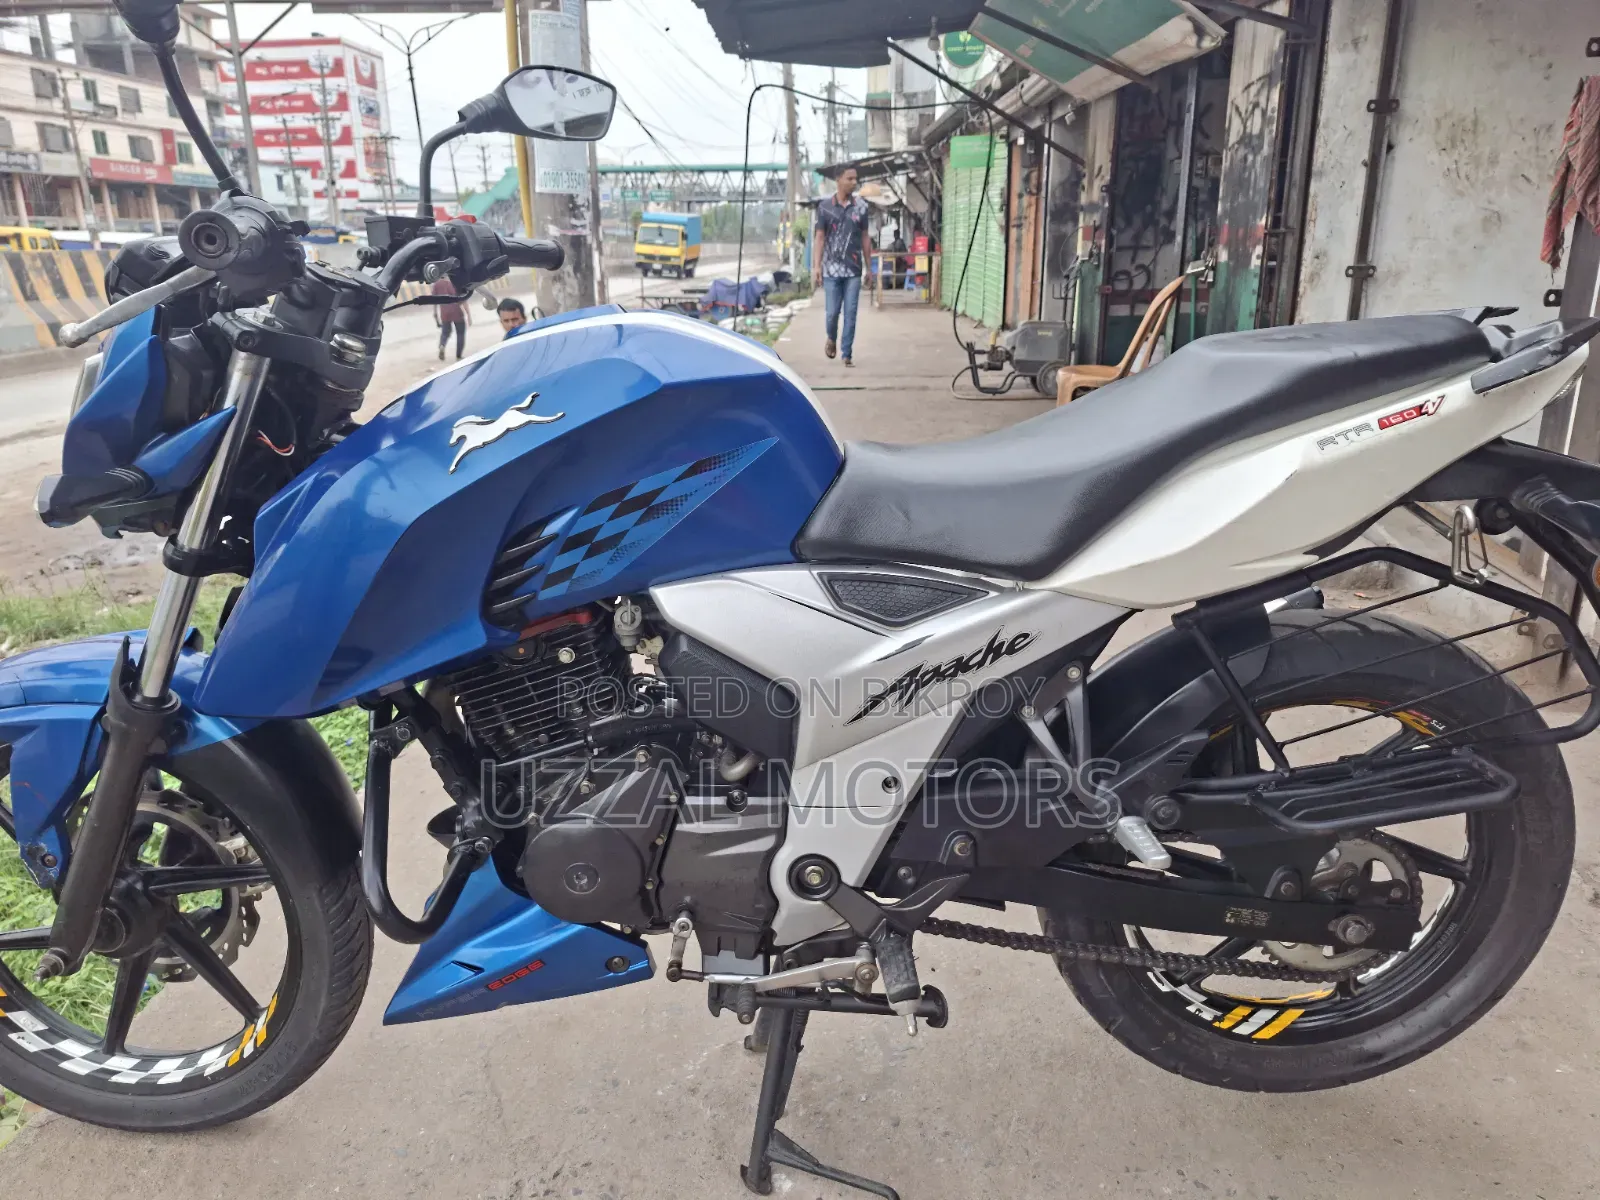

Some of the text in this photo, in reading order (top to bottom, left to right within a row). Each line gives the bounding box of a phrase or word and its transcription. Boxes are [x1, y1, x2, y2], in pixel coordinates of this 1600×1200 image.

[1316, 422, 1374, 451] RTR
[1381, 408, 1417, 426] 160
[843, 625, 1042, 726] Apache
